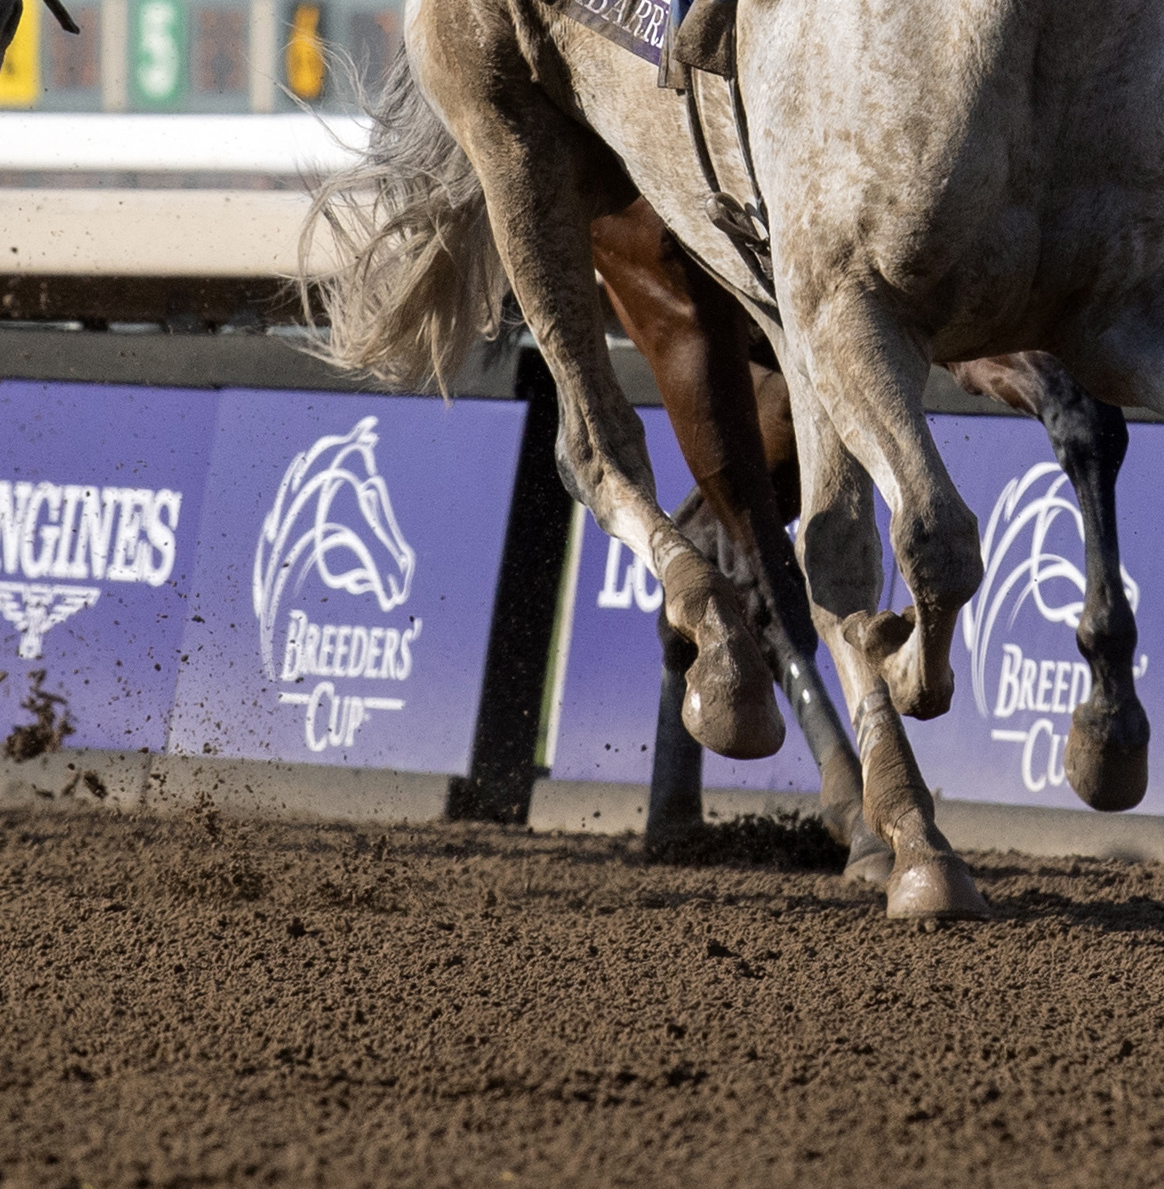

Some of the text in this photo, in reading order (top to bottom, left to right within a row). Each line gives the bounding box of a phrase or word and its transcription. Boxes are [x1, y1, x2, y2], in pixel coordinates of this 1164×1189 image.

[0, 479, 183, 587] NGINES
[280, 609, 423, 681] BREEDERS'
[993, 643, 1149, 718] BREED'
[306, 681, 366, 752] CUP
[1022, 718, 1067, 792] CU
